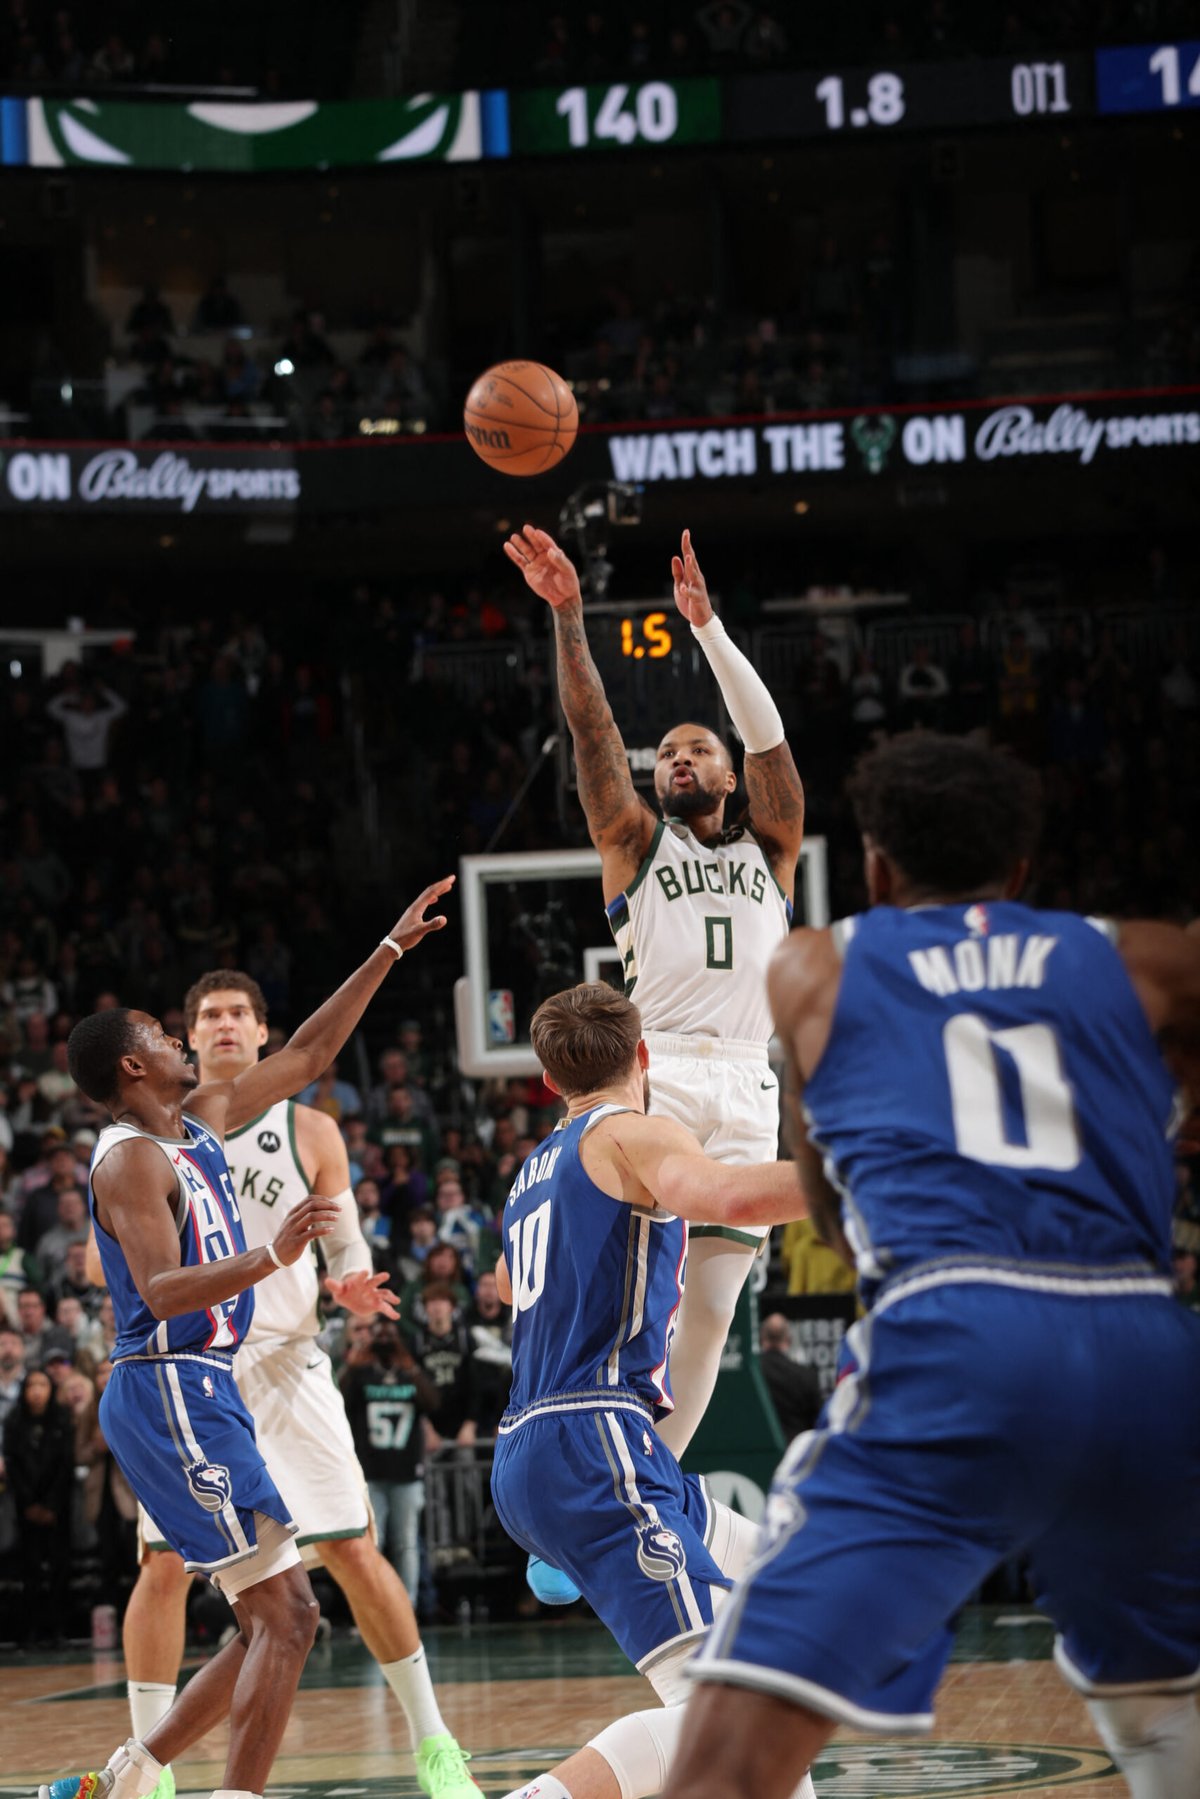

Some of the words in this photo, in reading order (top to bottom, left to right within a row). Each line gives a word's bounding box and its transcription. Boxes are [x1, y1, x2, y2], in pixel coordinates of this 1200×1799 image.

[557, 82, 678, 147] 140
[816, 73, 905, 129] 1.8
[1011, 62, 1071, 115] OT1
[608, 434, 756, 482] WATCH
[764, 423, 844, 472] THE
[902, 415, 966, 465] ON
[974, 404, 1104, 464] Bally
[1105, 412, 1200, 449] SPORTS
[7, 453, 71, 501] ON
[78, 449, 206, 513] Bally
[206, 468, 301, 500] SPORTS
[620, 612, 673, 660] 1.5
[655, 860, 767, 905] BUCKS
[704, 916, 733, 970] 0
[907, 934, 1058, 998] MONK
[942, 1013, 1081, 1172] 0
[508, 1198, 552, 1324] 10
[366, 1401, 415, 1450] 57
